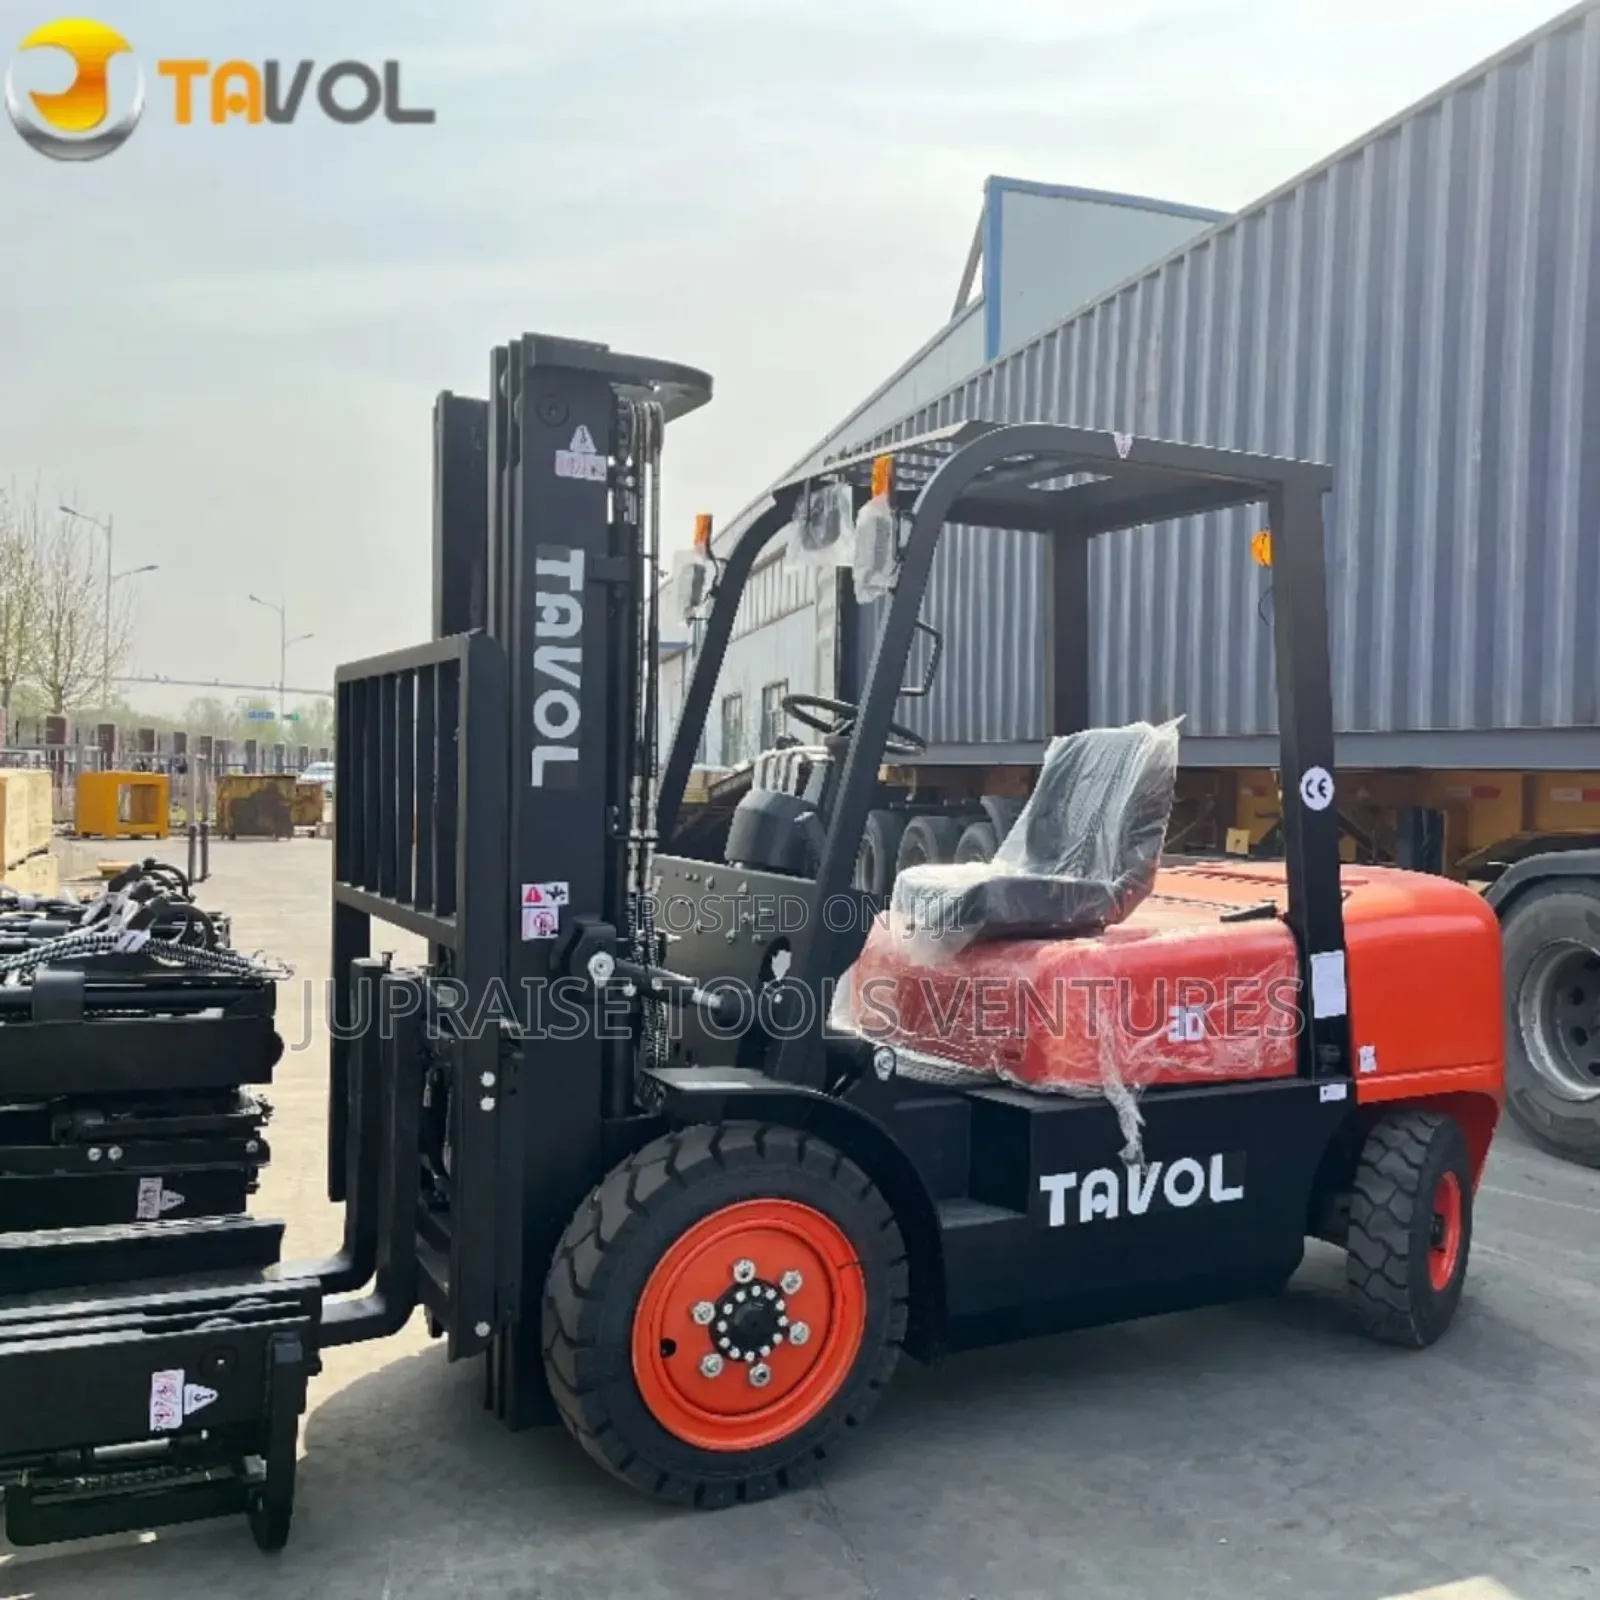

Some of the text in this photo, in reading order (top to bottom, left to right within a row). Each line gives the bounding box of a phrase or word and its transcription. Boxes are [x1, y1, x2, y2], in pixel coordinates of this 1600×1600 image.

[531, 549, 584, 788] TAVOL
[1306, 777, 1328, 799] CE
[1040, 1153, 1244, 1227] TAVOL
